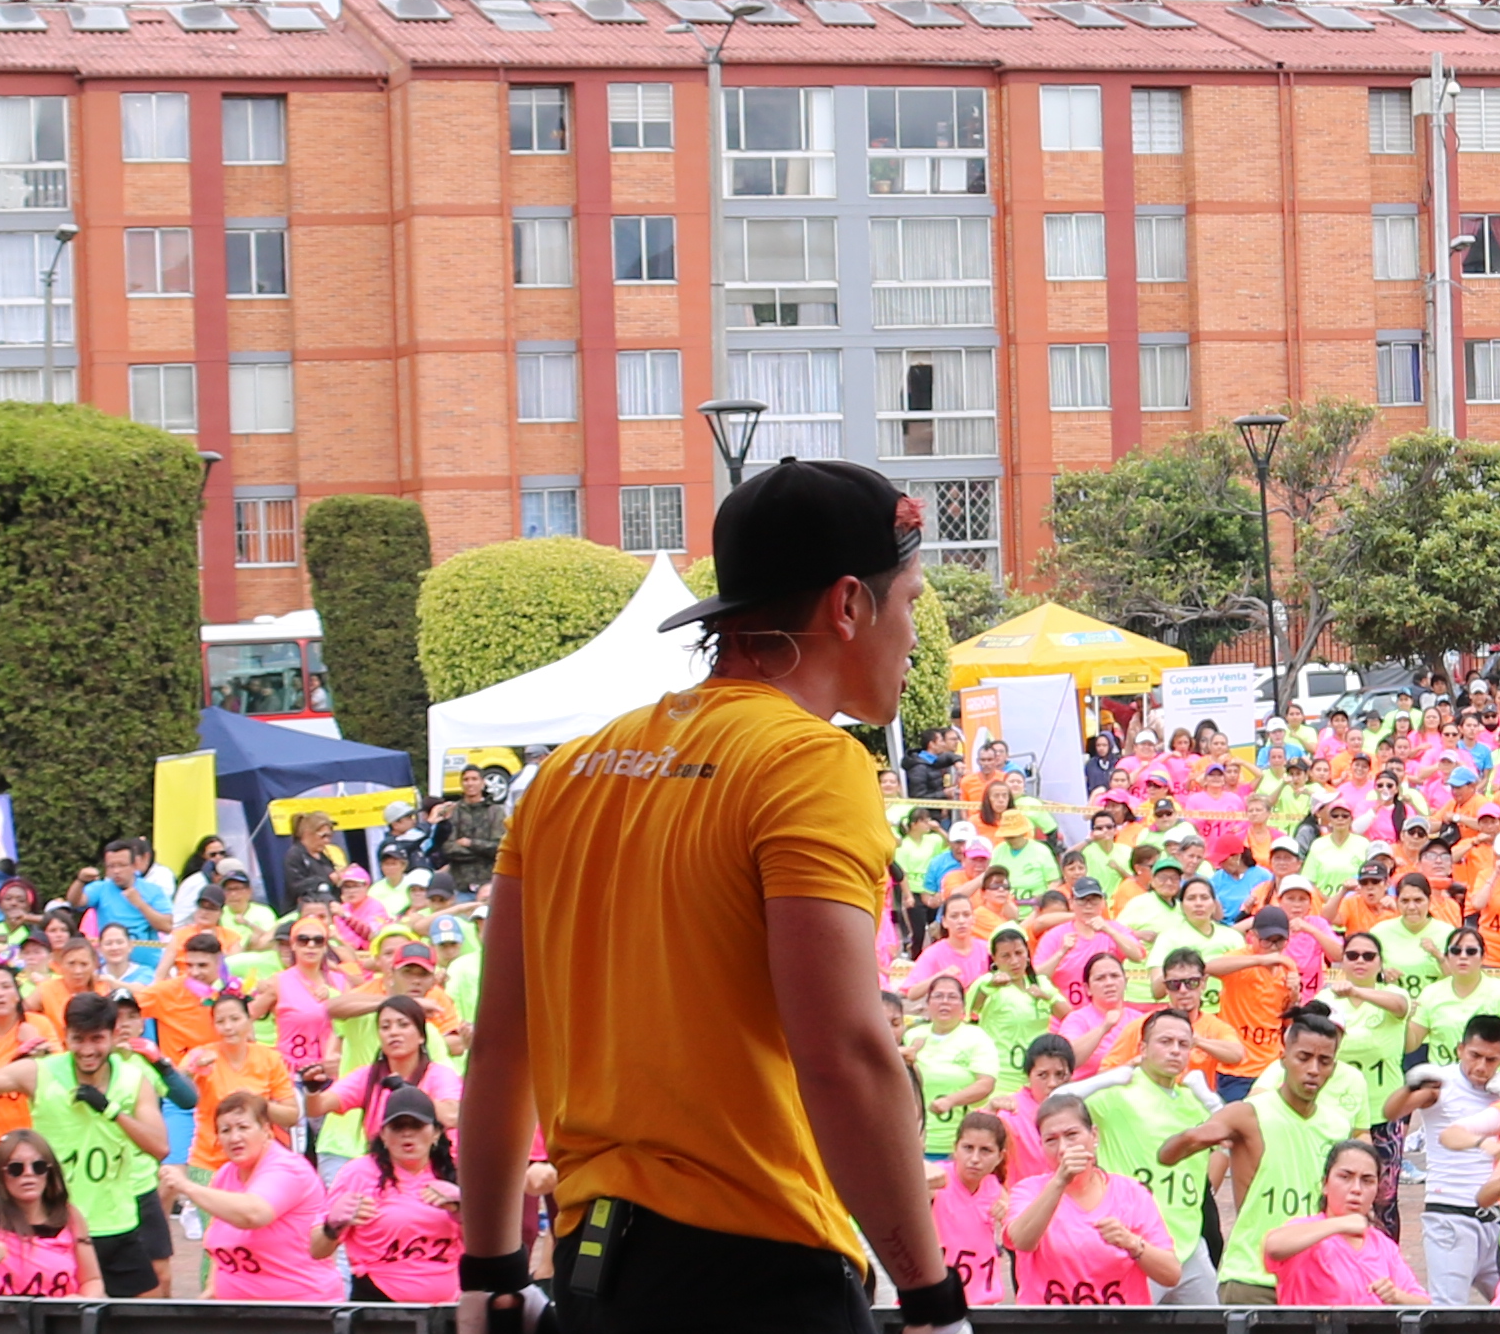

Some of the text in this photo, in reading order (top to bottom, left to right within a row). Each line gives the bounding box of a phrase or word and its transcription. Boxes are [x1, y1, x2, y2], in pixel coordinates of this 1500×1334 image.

[1169, 673, 1209, 685] Compra
[1218, 672, 1247, 682] Venta
[1171, 688, 1183, 696] de
[1223, 684, 1248, 693] Euros
